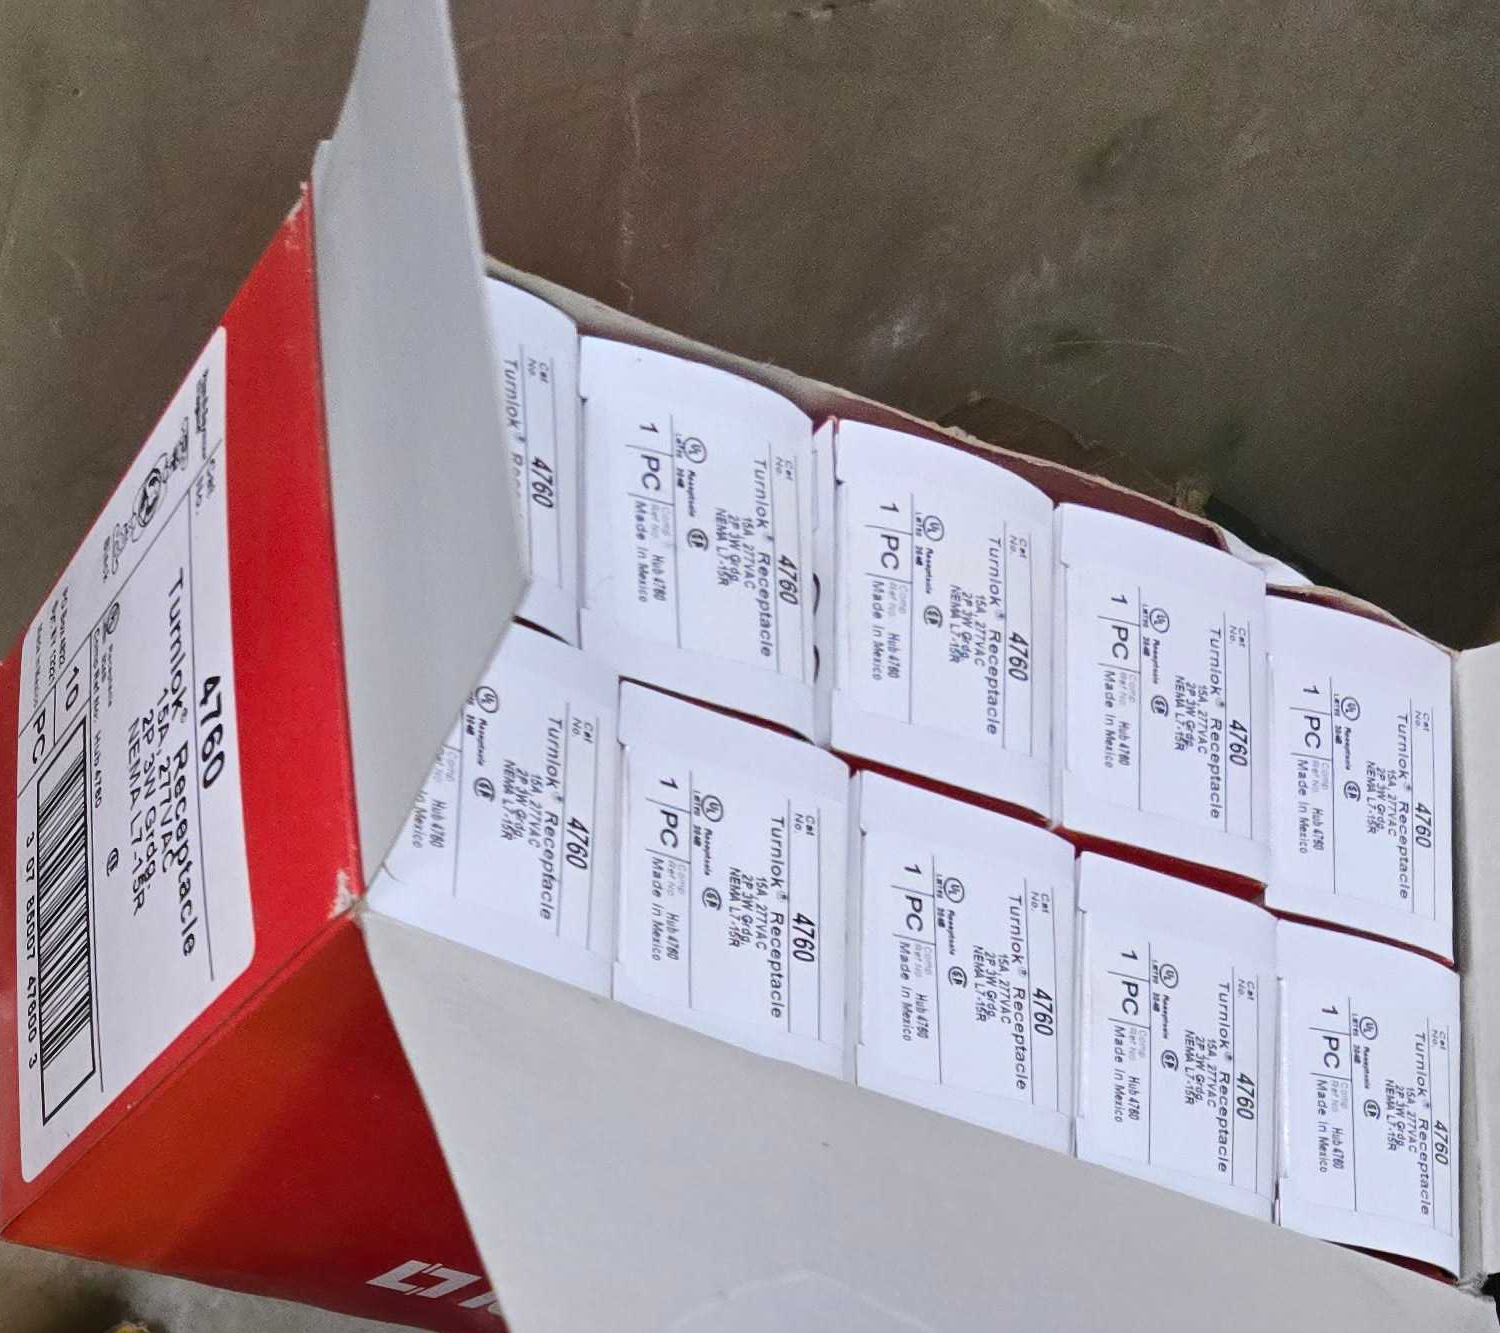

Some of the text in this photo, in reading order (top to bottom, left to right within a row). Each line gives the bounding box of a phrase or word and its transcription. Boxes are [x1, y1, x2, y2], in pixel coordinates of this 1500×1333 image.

[530, 455, 555, 510] 4760
[639, 452, 661, 494] PC
[777, 552, 801, 607] 4760
[879, 531, 899, 573] PC
[753, 549, 774, 658] Receptacle
[1006, 629, 1028, 683] 4760
[1110, 622, 1128, 663] PC
[65, 665, 79, 712] 10
[983, 627, 1001, 734] Receptacle
[32, 706, 46, 765] PC
[200, 675, 225, 789] 4760
[1228, 717, 1248, 769] 4760
[1304, 714, 1321, 753] PC
[128, 715, 141, 806] NEMA
[1208, 715, 1223, 820] Receptacle
[174, 740, 197, 957] Receptacle
[564, 815, 590, 874] 4760
[657, 808, 678, 852] PC
[1394, 800, 1409, 900] Receptacle
[1413, 801, 1432, 851] 4760
[537, 809, 559, 923] Receptacle
[792, 911, 814, 967] 4760
[903, 894, 923, 935] PC
[768, 908, 785, 1020] Receptacle
[1031, 987, 1054, 1040] 4760
[1120, 978, 1138, 1019] PC
[1009, 985, 1028, 1092] Receptacle
[1323, 1034, 1341, 1071] PC
[1215, 1070, 1230, 1173] Receptacle
[1235, 1072, 1254, 1123] 4760
[1414, 1116, 1431, 1216] Receptacle
[1432, 1117, 1452, 1166] 4760
